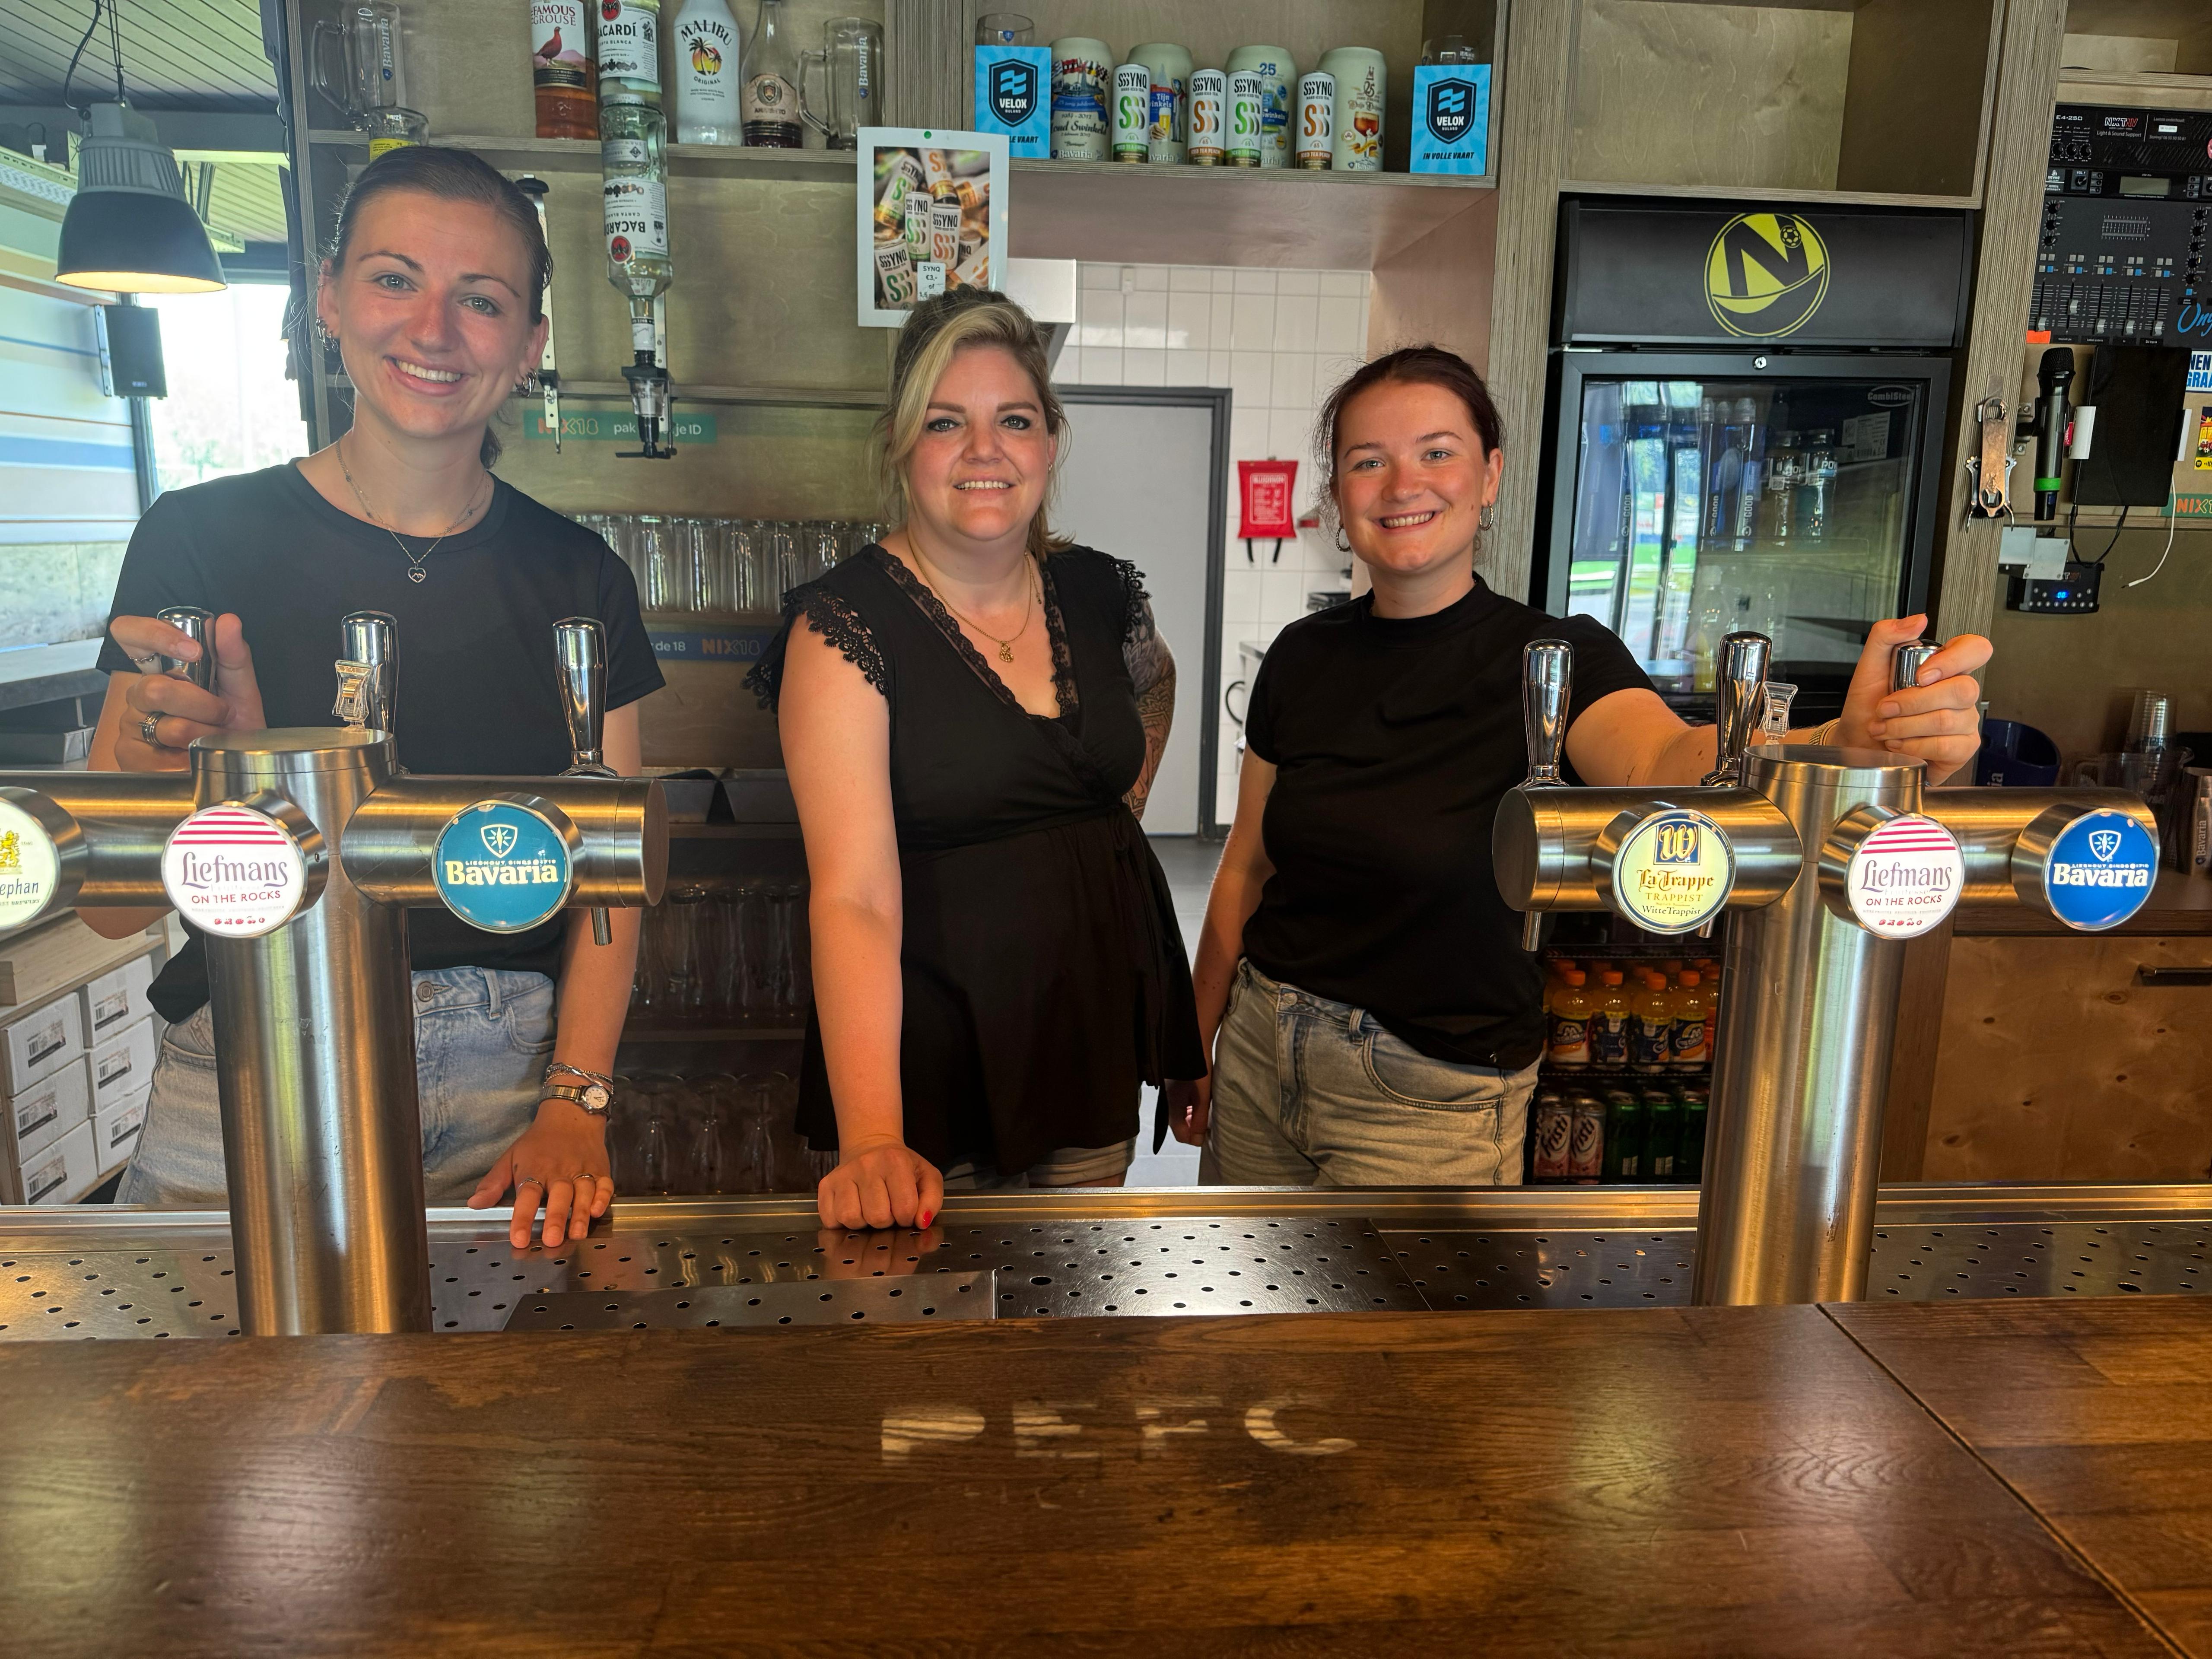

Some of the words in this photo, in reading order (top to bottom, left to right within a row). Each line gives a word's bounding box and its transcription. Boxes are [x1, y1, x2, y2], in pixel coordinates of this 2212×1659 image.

[534, 5, 575, 16] FAMOUS
[534, 15, 576, 26] GROUSE
[598, 22, 636, 37] ACARDÍ
[681, 19, 732, 45] MALIBU
[381, 18, 393, 68] Bavaria
[1259, 63, 1276, 75] 25
[694, 76, 721, 85] ORIGINAL
[999, 98, 1027, 108] VELOX
[1437, 116, 1464, 126] VELOX
[1059, 150, 1092, 159] Bavaria
[605, 221, 645, 235] BACARD
[614, 423, 636, 435] pak
[674, 424, 687, 437] je
[689, 424, 702, 435] ID
[1744, 495, 1753, 518] GOOD
[656, 642, 671, 652] de
[674, 642, 686, 652] 18
[702, 639, 760, 656] NIX18
[2196, 820, 2206, 856] Bavaria
[181, 852, 288, 889] Liefmans
[445, 861, 558, 885] Bavaria
[1860, 860, 1952, 893] Liefmans
[2053, 863, 2148, 887] Bavaria
[1637, 869, 1655, 892] La
[1657, 870, 1714, 891] Trappe
[191, 895, 209, 904] ON
[213, 894, 236, 903] THE
[241, 890, 281, 902] ROCKS
[1645, 893, 1703, 902] TRAPPIST
[1885, 898, 1904, 906] THE
[1907, 895, 1942, 905] ROCKS
[881, 1395, 1359, 1465] PEFC
